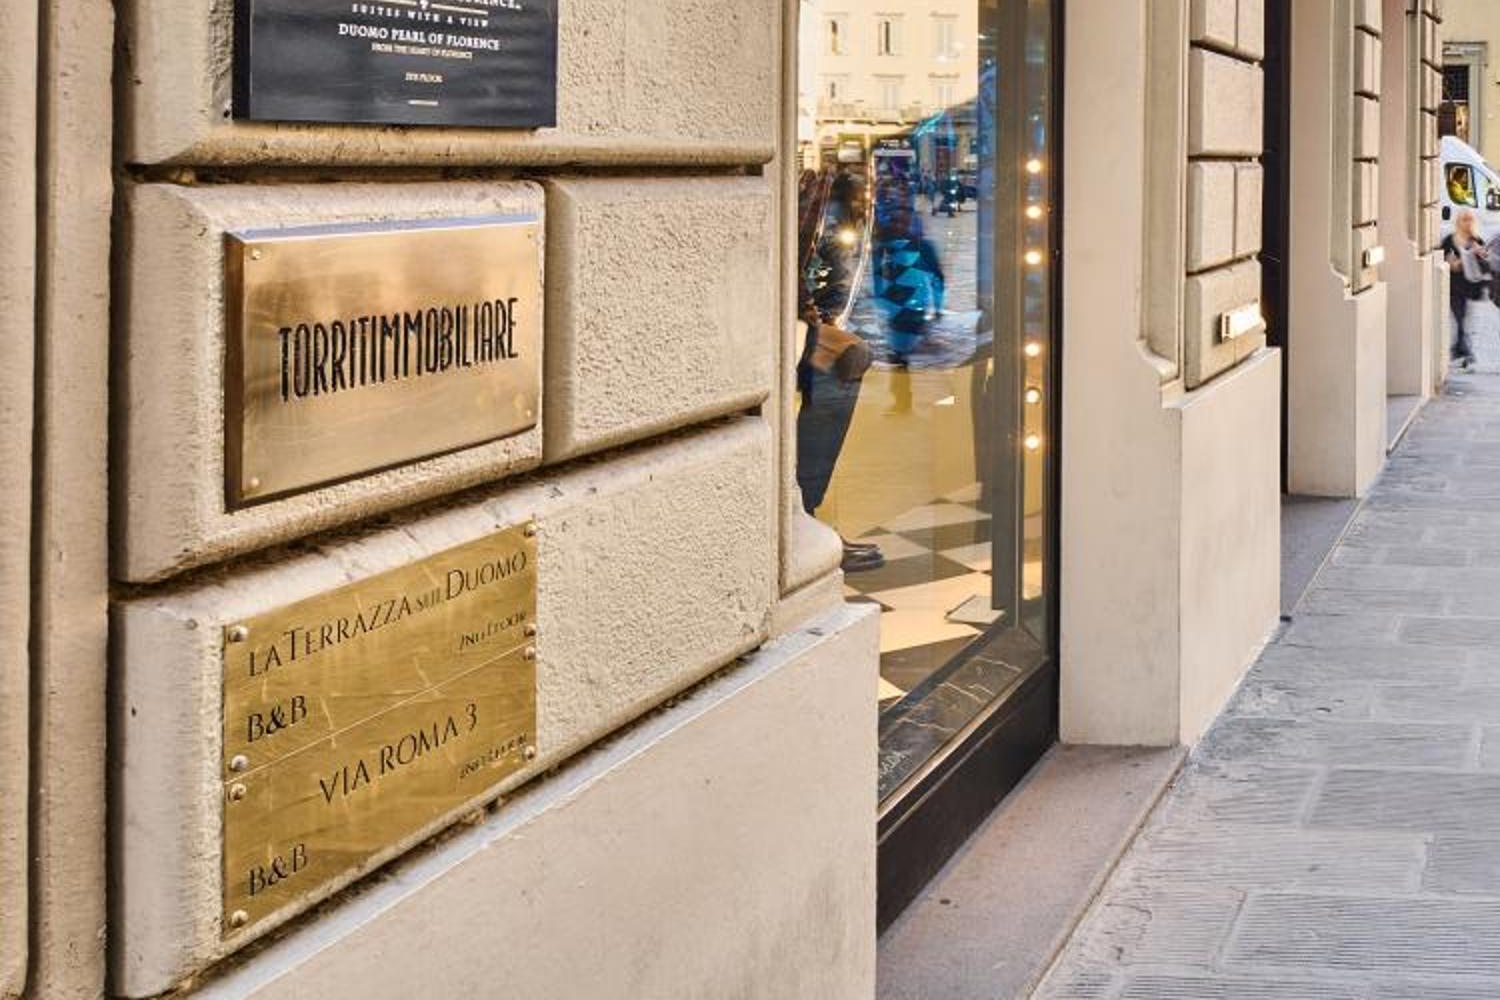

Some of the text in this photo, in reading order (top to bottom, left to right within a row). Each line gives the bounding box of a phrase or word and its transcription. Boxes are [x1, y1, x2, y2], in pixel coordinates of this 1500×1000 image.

[338, 22, 500, 51] DUOMO PEARL OF FLORENCE
[352, 3, 489, 27] SUITES WITH A VIEW
[278, 297, 519, 402] TORRITIMMOBILIARE
[248, 643, 283, 677] LA
[284, 594, 412, 664] TERRAZZA
[446, 550, 527, 600] DUOMO
[246, 694, 308, 743] B&B
[319, 702, 478, 805] VIA ROMA 3
[248, 843, 308, 897] B&B
